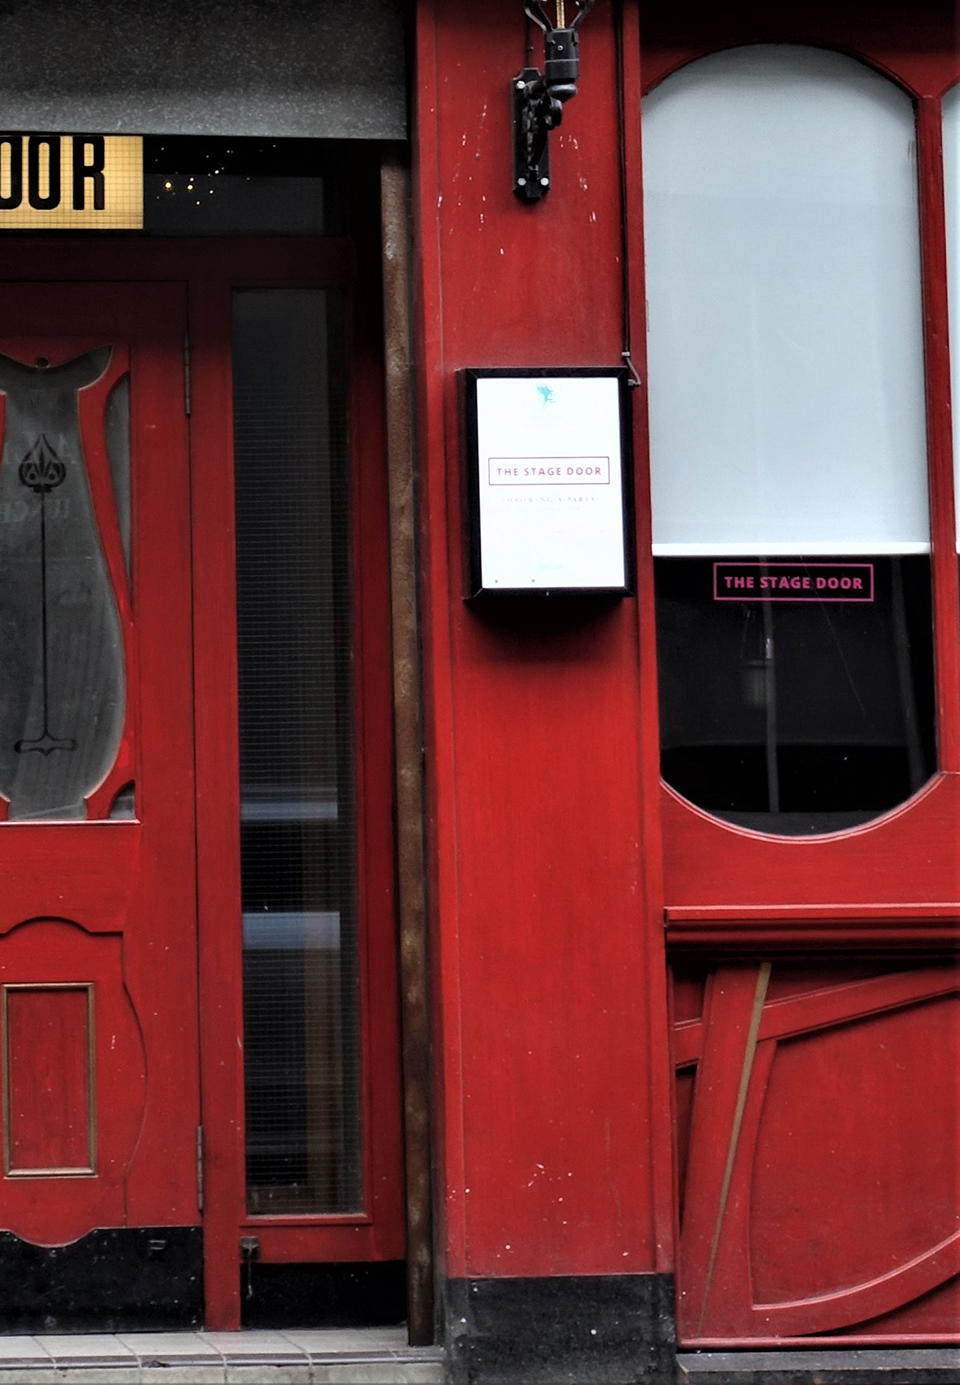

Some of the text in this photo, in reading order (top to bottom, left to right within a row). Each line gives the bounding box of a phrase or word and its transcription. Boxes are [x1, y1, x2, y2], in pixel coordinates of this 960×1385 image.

[497, 466, 602, 477] THE STAGE DOOR
[724, 576, 863, 590] THE STAGE DOOR
